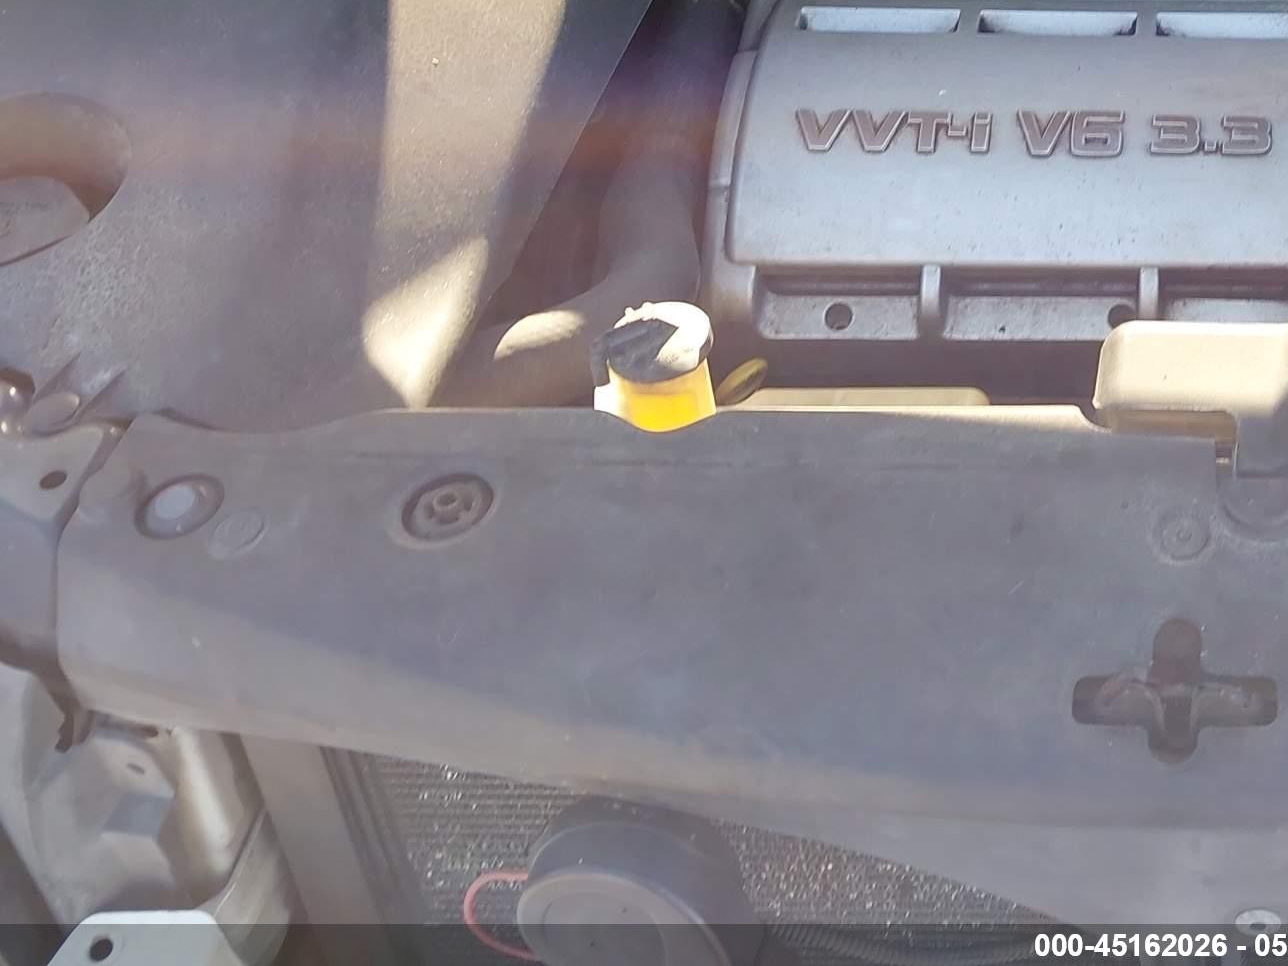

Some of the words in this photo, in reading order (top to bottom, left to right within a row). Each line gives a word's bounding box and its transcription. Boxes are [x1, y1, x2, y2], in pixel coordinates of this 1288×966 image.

[796, 108, 993, 154] VVT-i
[1016, 109, 1126, 157] V6
[1149, 113, 1273, 156] 3.3
